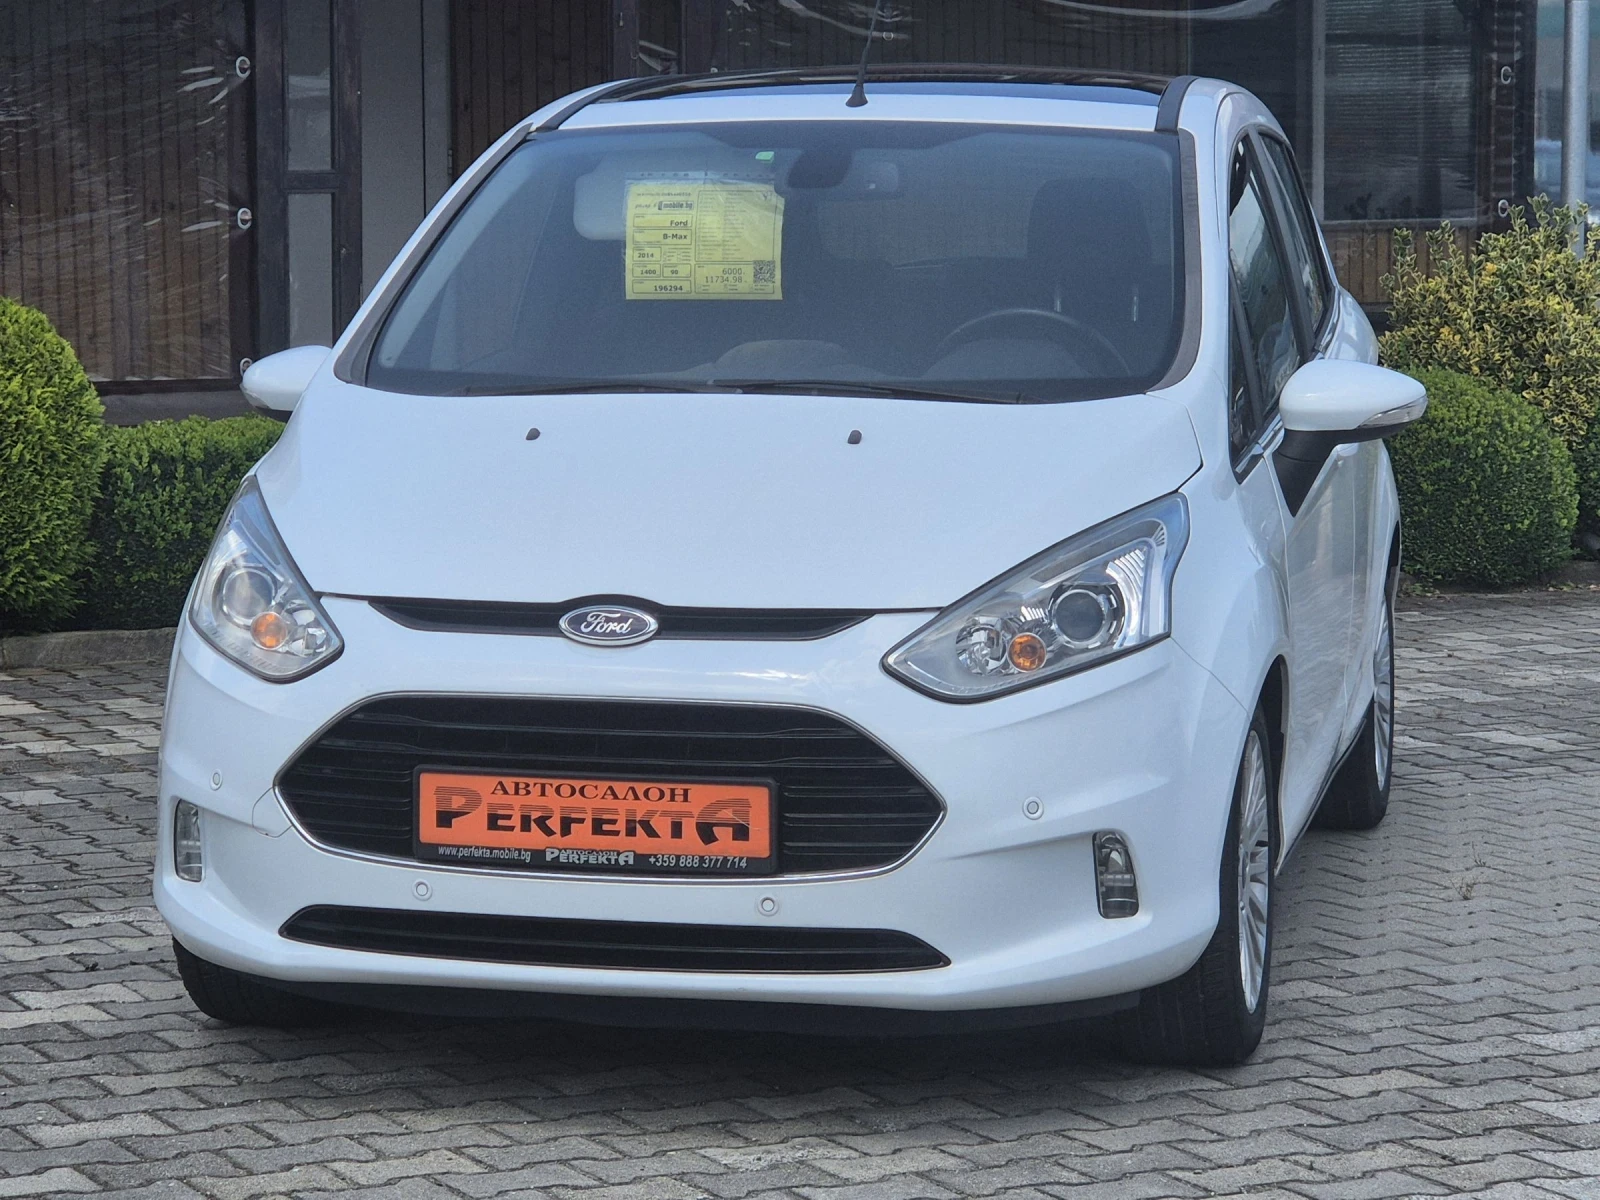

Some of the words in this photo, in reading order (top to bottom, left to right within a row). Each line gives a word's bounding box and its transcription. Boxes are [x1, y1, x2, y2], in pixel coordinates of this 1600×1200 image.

[662, 202, 693, 210] mobile.bg
[653, 284, 684, 292] 196294
[580, 612, 633, 634] Ford
[489, 780, 692, 803] АВТОСАЛОН
[433, 785, 753, 847] PERFEKTA
[438, 845, 531, 863] www.perfekta.mobile.bg
[545, 847, 634, 866] PERFEKTA
[648, 854, 676, 867] +359
[679, 855, 700, 867] 888
[702, 856, 723, 869] 377
[726, 856, 747, 869] 714
